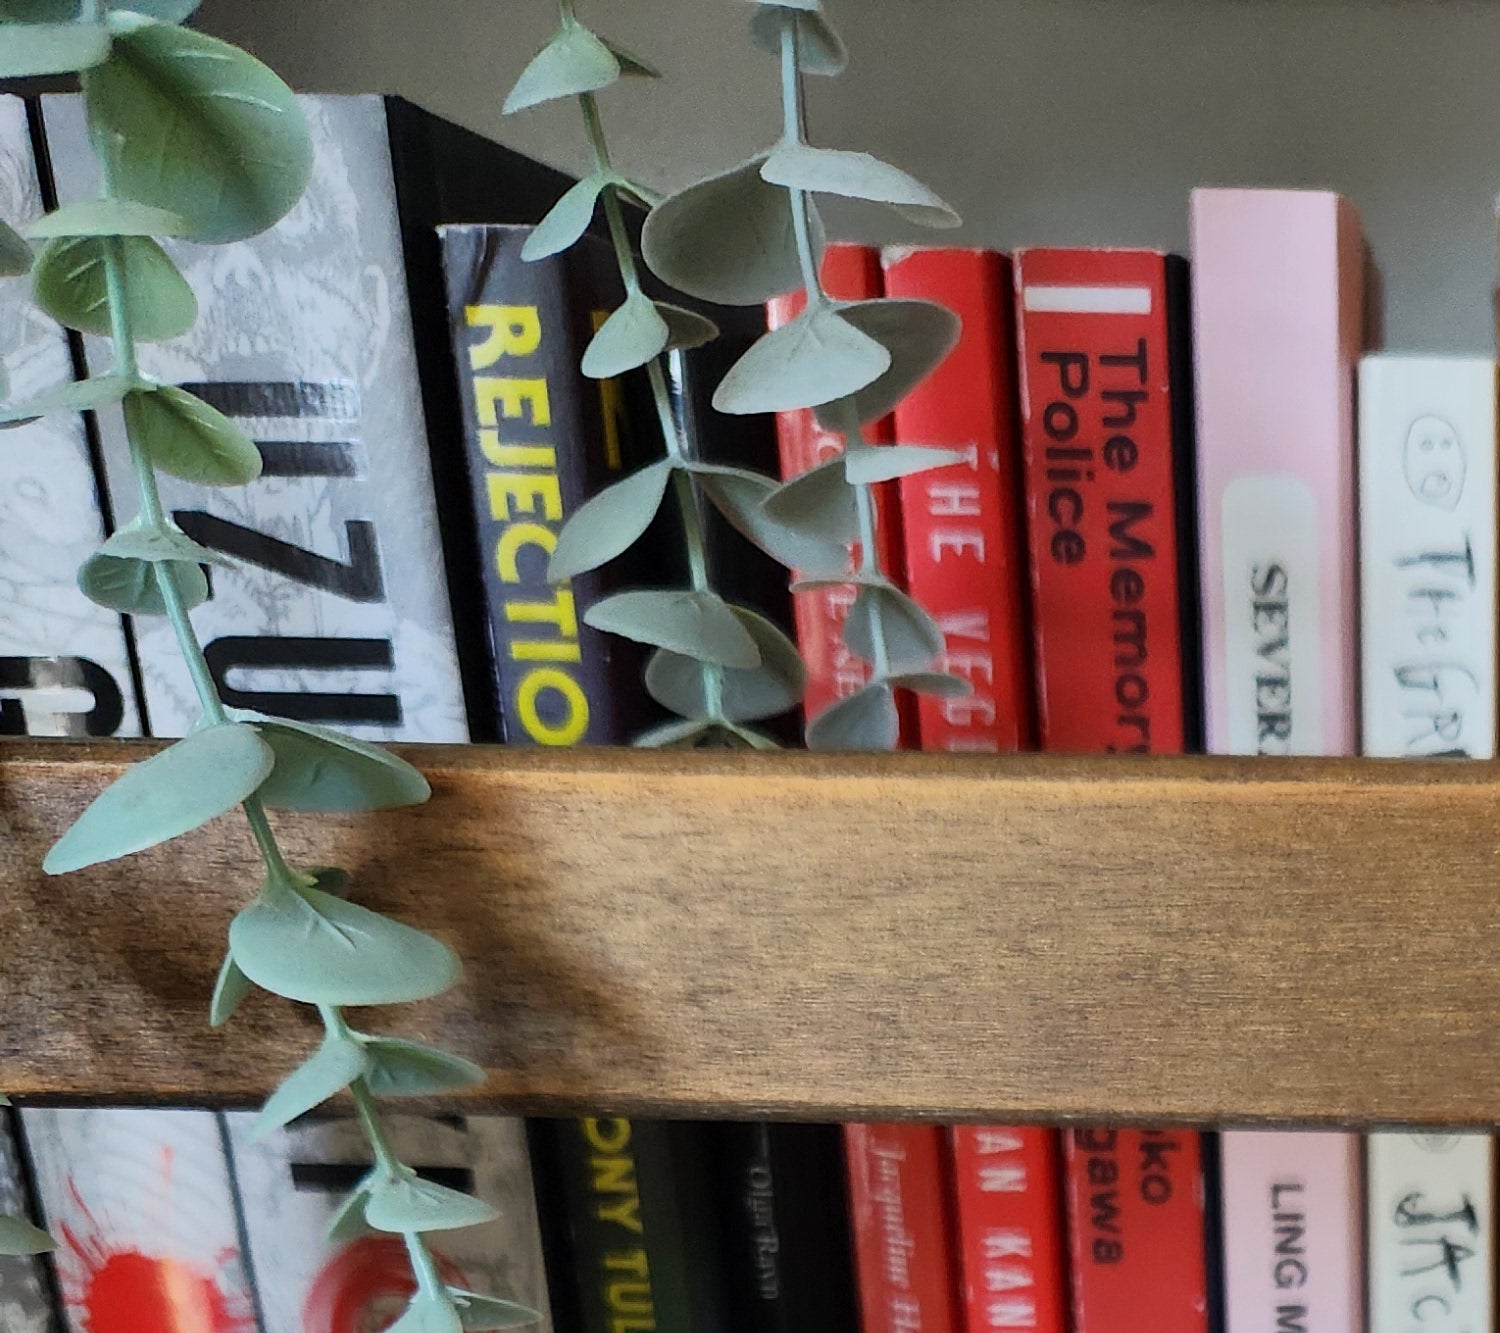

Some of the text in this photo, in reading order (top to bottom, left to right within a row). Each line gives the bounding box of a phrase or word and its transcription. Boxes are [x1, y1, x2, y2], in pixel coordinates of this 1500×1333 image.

[1040, 351, 1096, 565] Police
[465, 304, 591, 746] REJECTIO
[1099, 336, 1156, 754] The Memor
[1251, 561, 1292, 754] SEVER
[1394, 664, 1478, 757] GR
[583, 1117, 644, 1234] ONY
[976, 1132, 1028, 1192] AN
[1139, 1130, 1182, 1206] ko
[1271, 1181, 1310, 1290] LING
